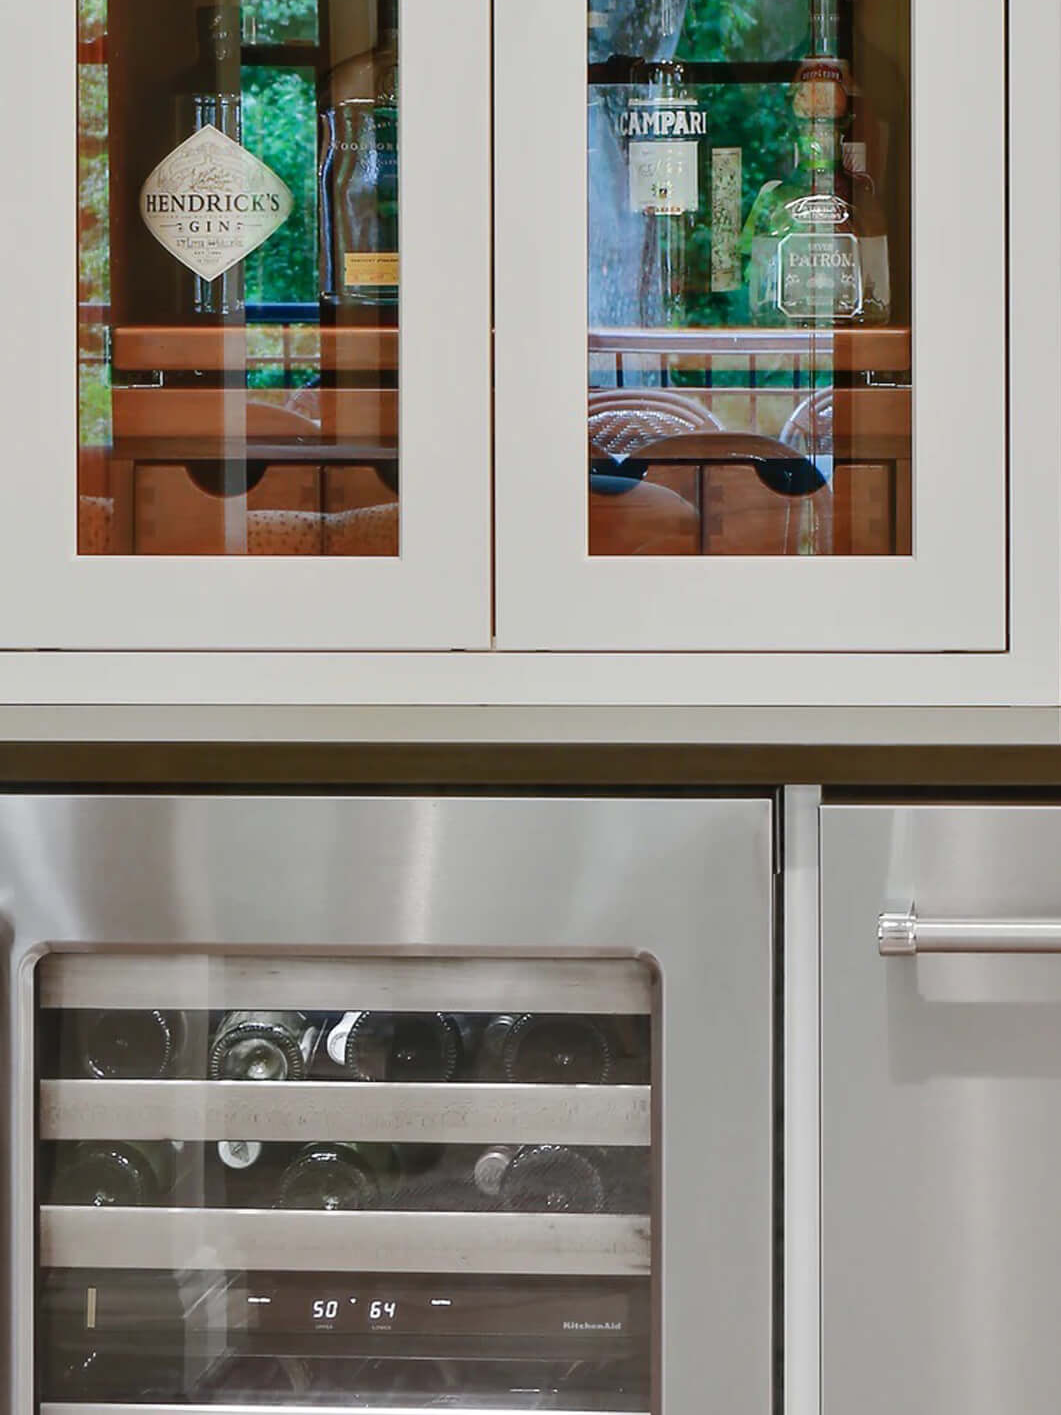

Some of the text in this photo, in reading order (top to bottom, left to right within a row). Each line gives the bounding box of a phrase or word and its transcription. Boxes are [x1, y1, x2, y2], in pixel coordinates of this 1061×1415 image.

[618, 110, 707, 135] CAMPARI
[146, 193, 280, 213] HENDRICK'S
[188, 220, 231, 233] GIN
[312, 1300, 396, 1319] 50 64
[563, 1321, 622, 1331] KitchenAid
